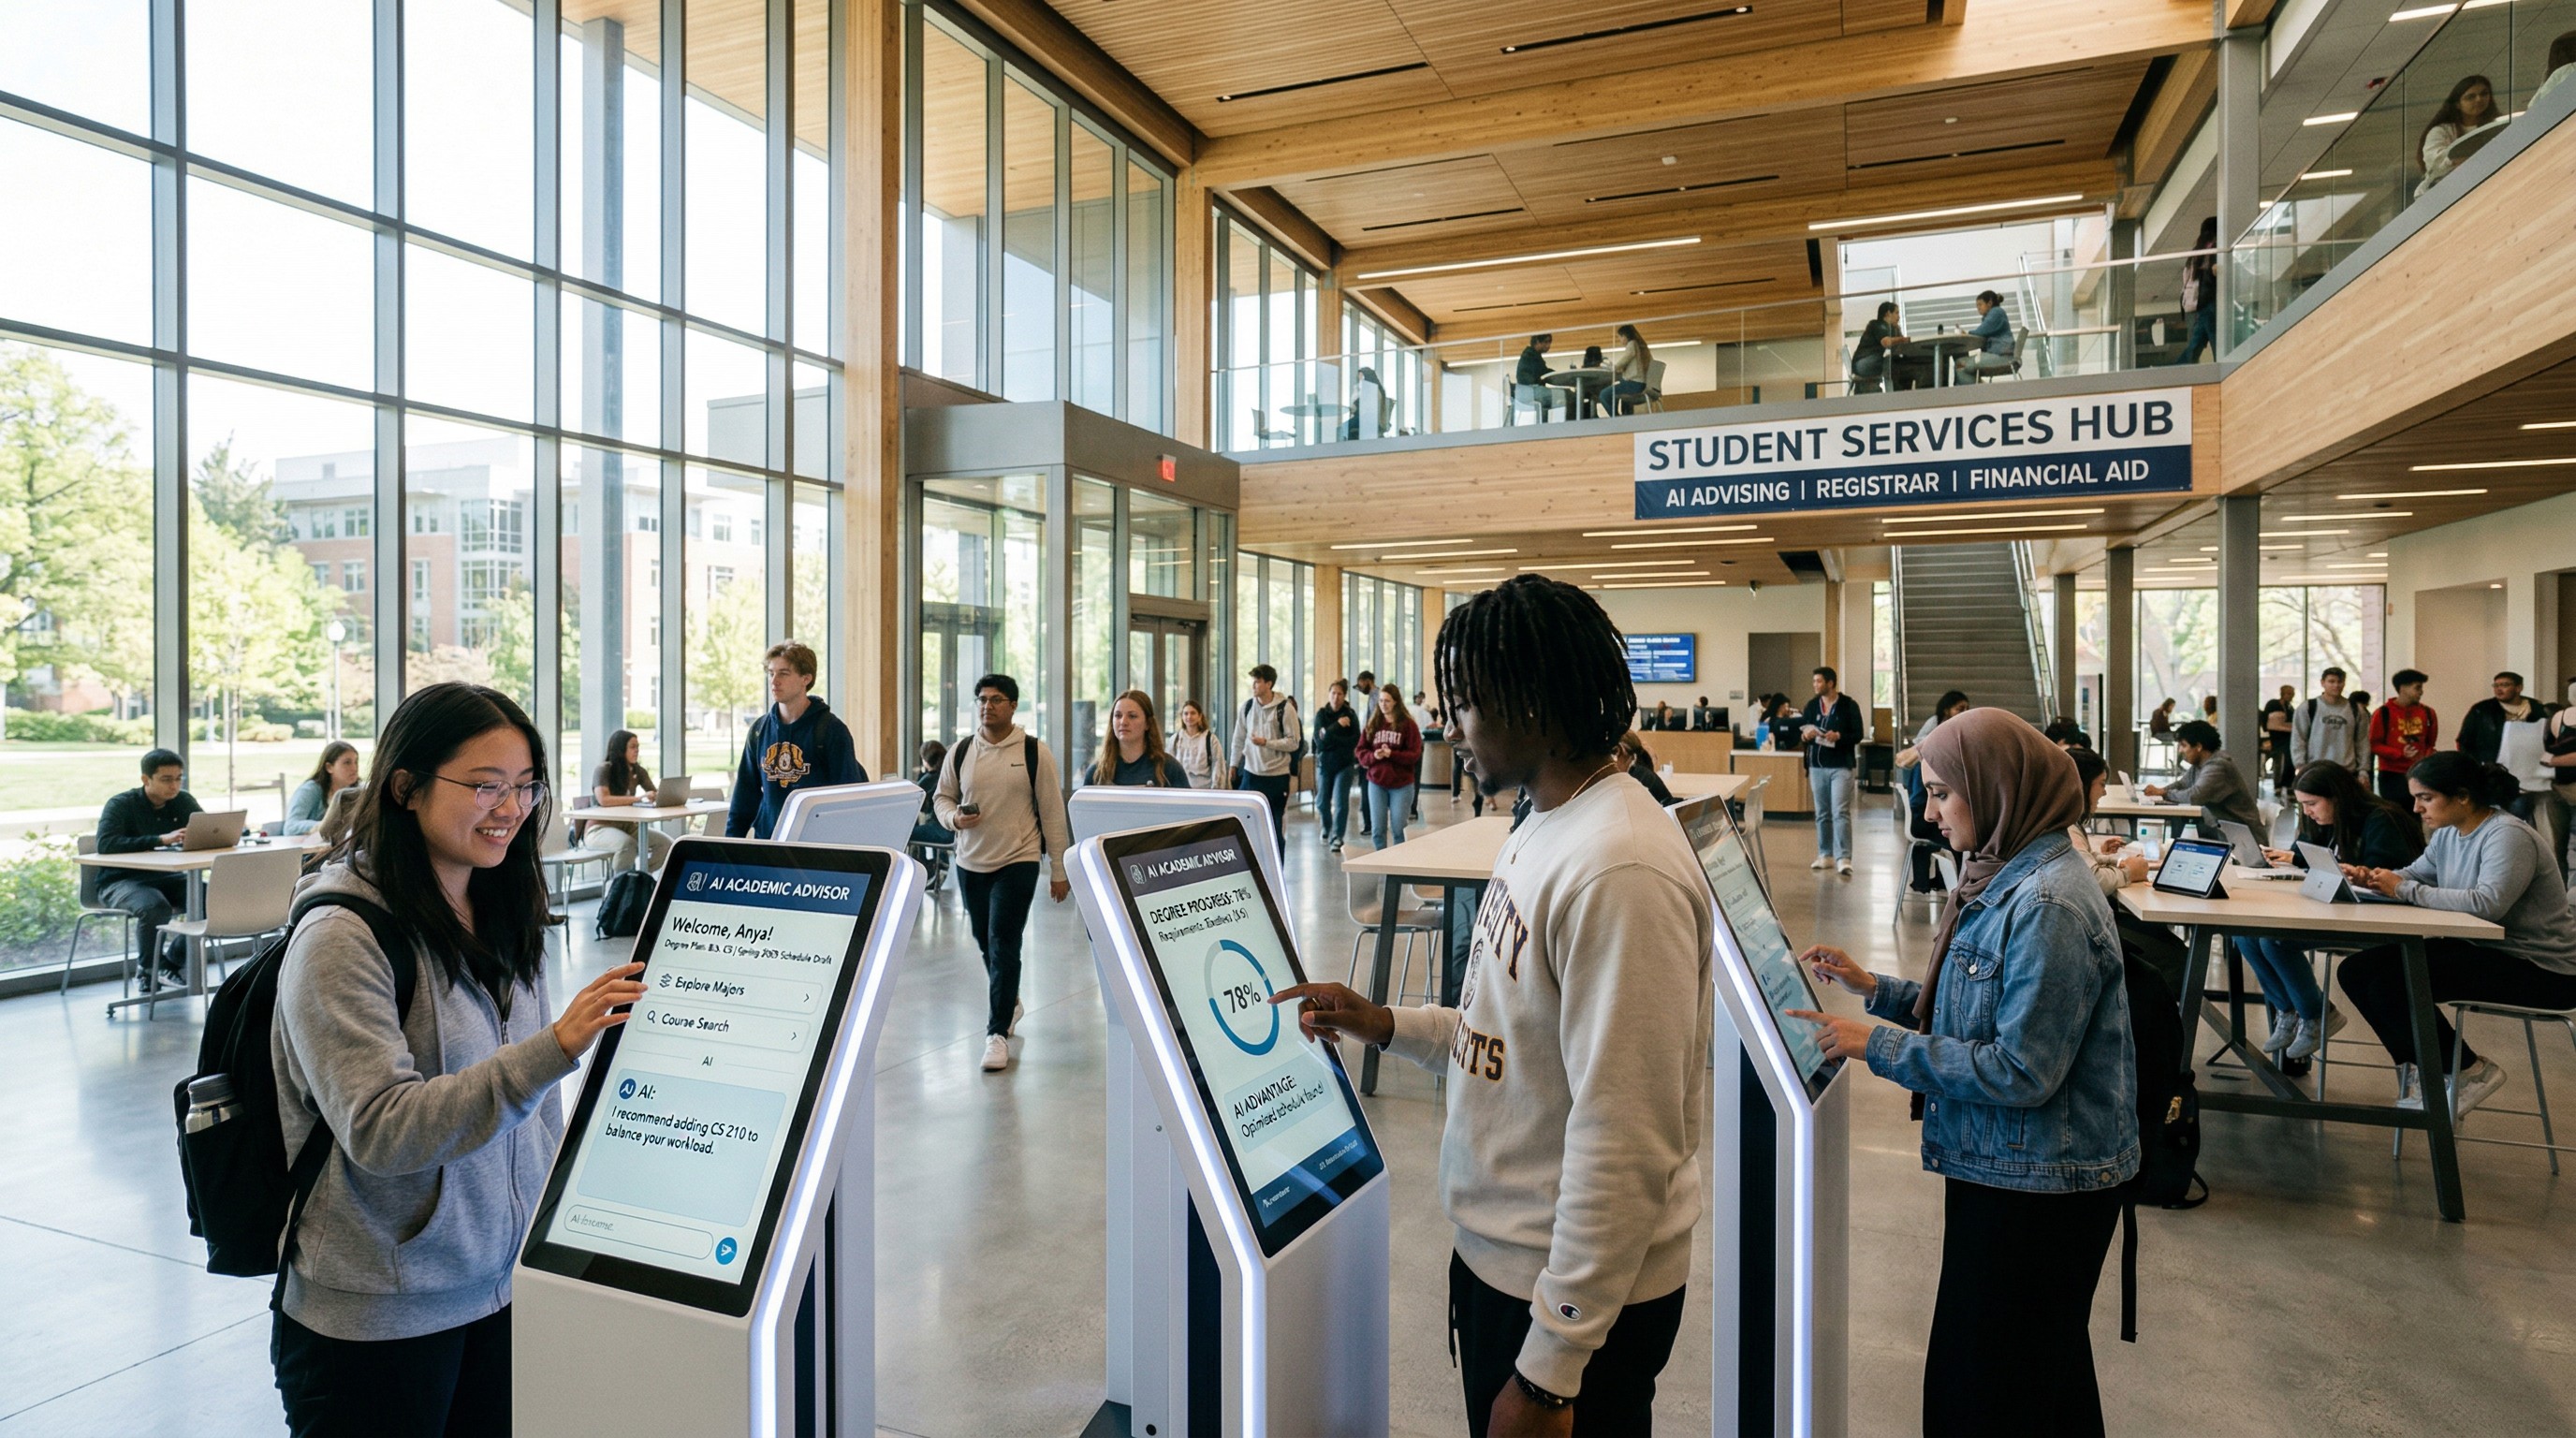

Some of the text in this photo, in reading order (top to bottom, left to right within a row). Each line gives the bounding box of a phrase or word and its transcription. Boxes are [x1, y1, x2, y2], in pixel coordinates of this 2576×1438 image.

[1647, 400, 2174, 471] STUDENT SERVICES HUB
[1666, 488, 1685, 507] AI
[1690, 481, 1790, 506] ADVISING
[1816, 473, 1939, 500] REGISTRAR
[1969, 463, 2097, 492] FINANCIAL
[2104, 460, 2149, 482] AID
[1148, 864, 1159, 879] AI
[710, 876, 850, 901] AI ACADEMIC ADVISOR
[672, 917, 774, 944] Welcome, Anya!
[712, 980, 745, 998] Majors
[1223, 981, 1261, 1013] 78%
[701, 1056, 714, 1067] AI
[637, 1084, 657, 1100] AI:
[605, 1123, 714, 1155] balance your workload.
[617, 1109, 675, 1127] recommend
[674, 1117, 709, 1137] adding
[710, 1122, 724, 1137] CS
[725, 1124, 747, 1140] 210
[748, 1130, 759, 1142] to
